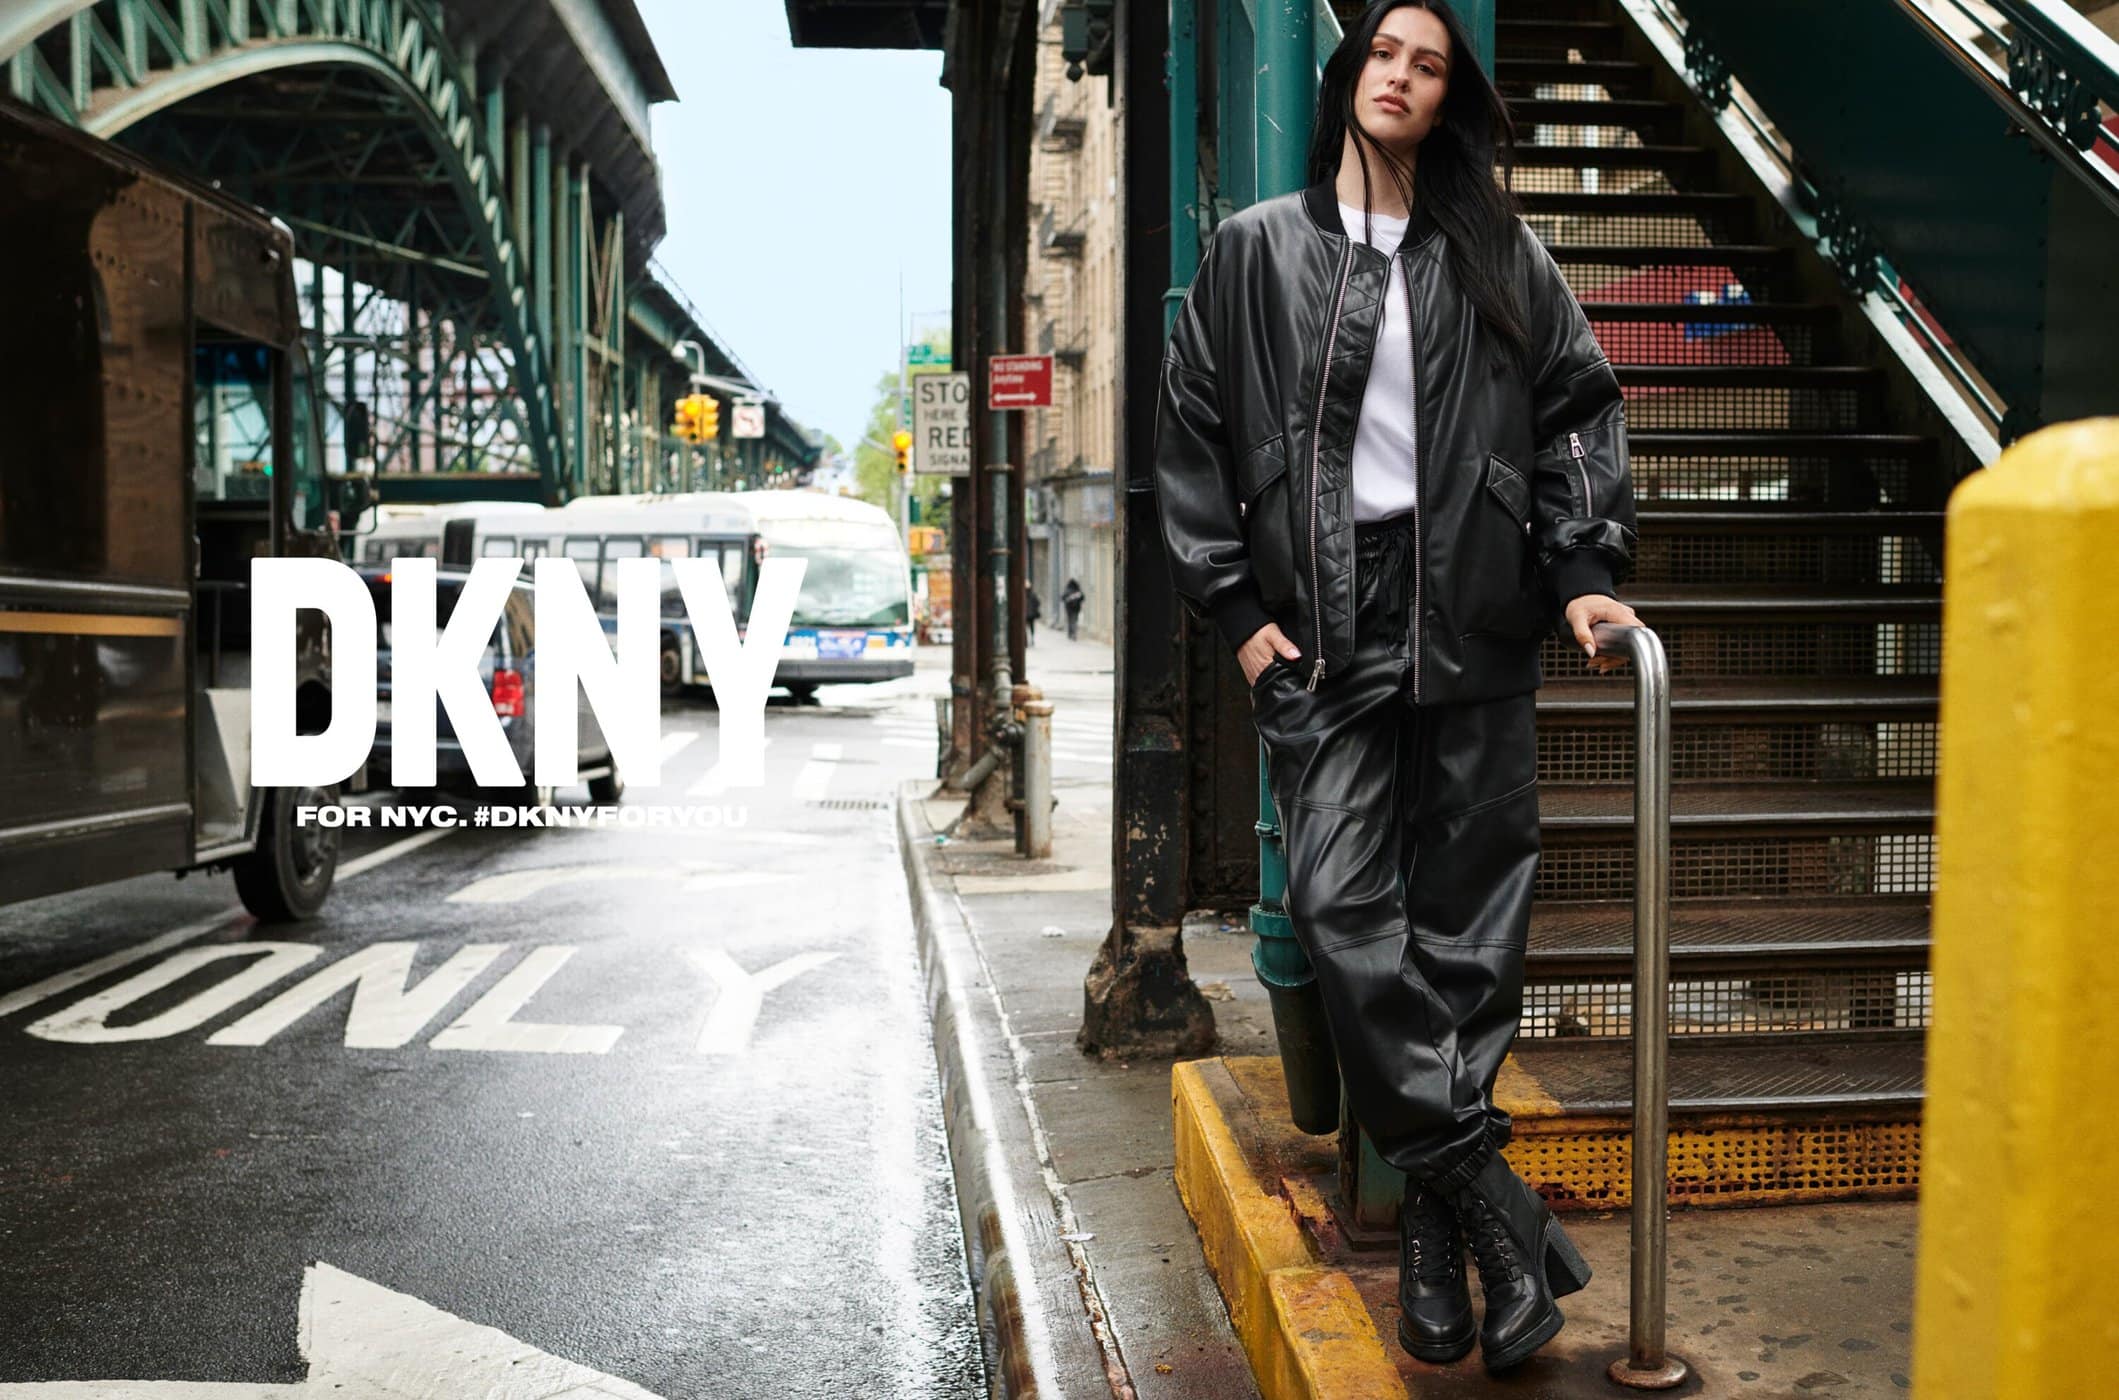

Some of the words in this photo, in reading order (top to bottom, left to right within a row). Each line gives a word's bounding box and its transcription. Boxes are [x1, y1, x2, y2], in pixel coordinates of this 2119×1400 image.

[921, 382, 970, 404] STO
[928, 455, 970, 466] SIGNA
[23, 942, 841, 1054] ONLY
